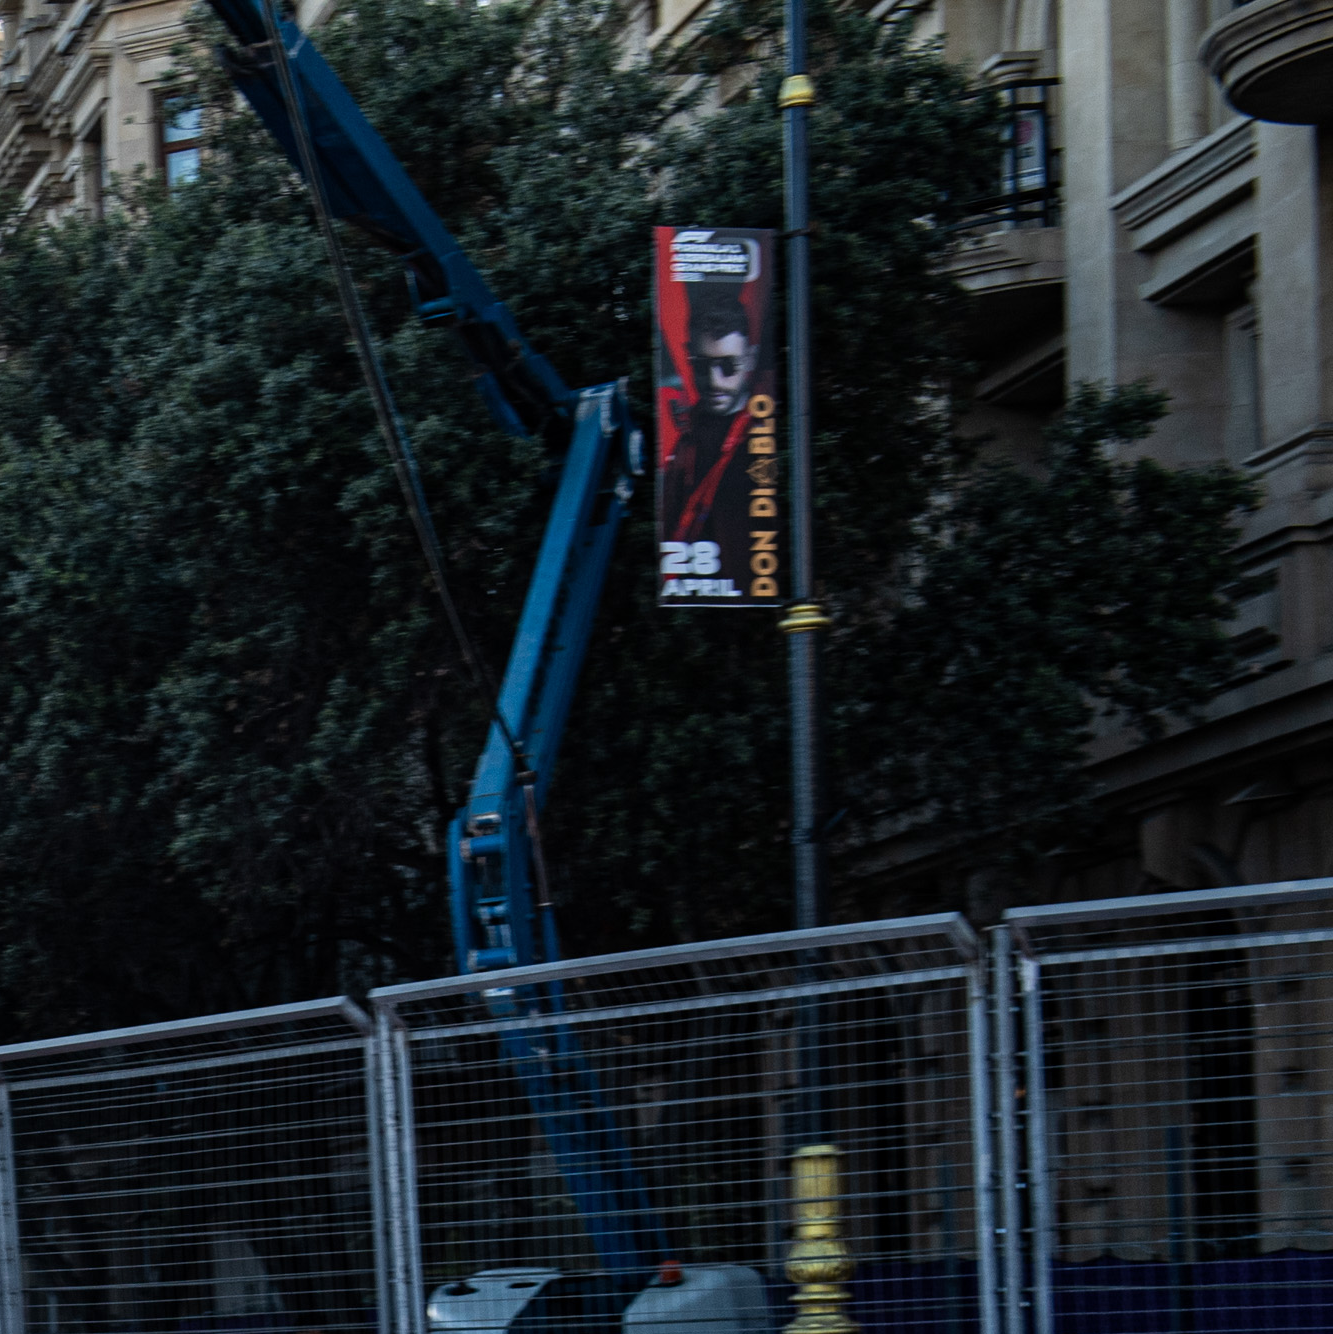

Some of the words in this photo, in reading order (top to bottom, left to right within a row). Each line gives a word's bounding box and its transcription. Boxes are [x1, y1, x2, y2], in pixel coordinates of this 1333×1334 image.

[659, 541, 721, 575] 28
[749, 530, 779, 596] DON
[661, 579, 743, 597] APRIL
